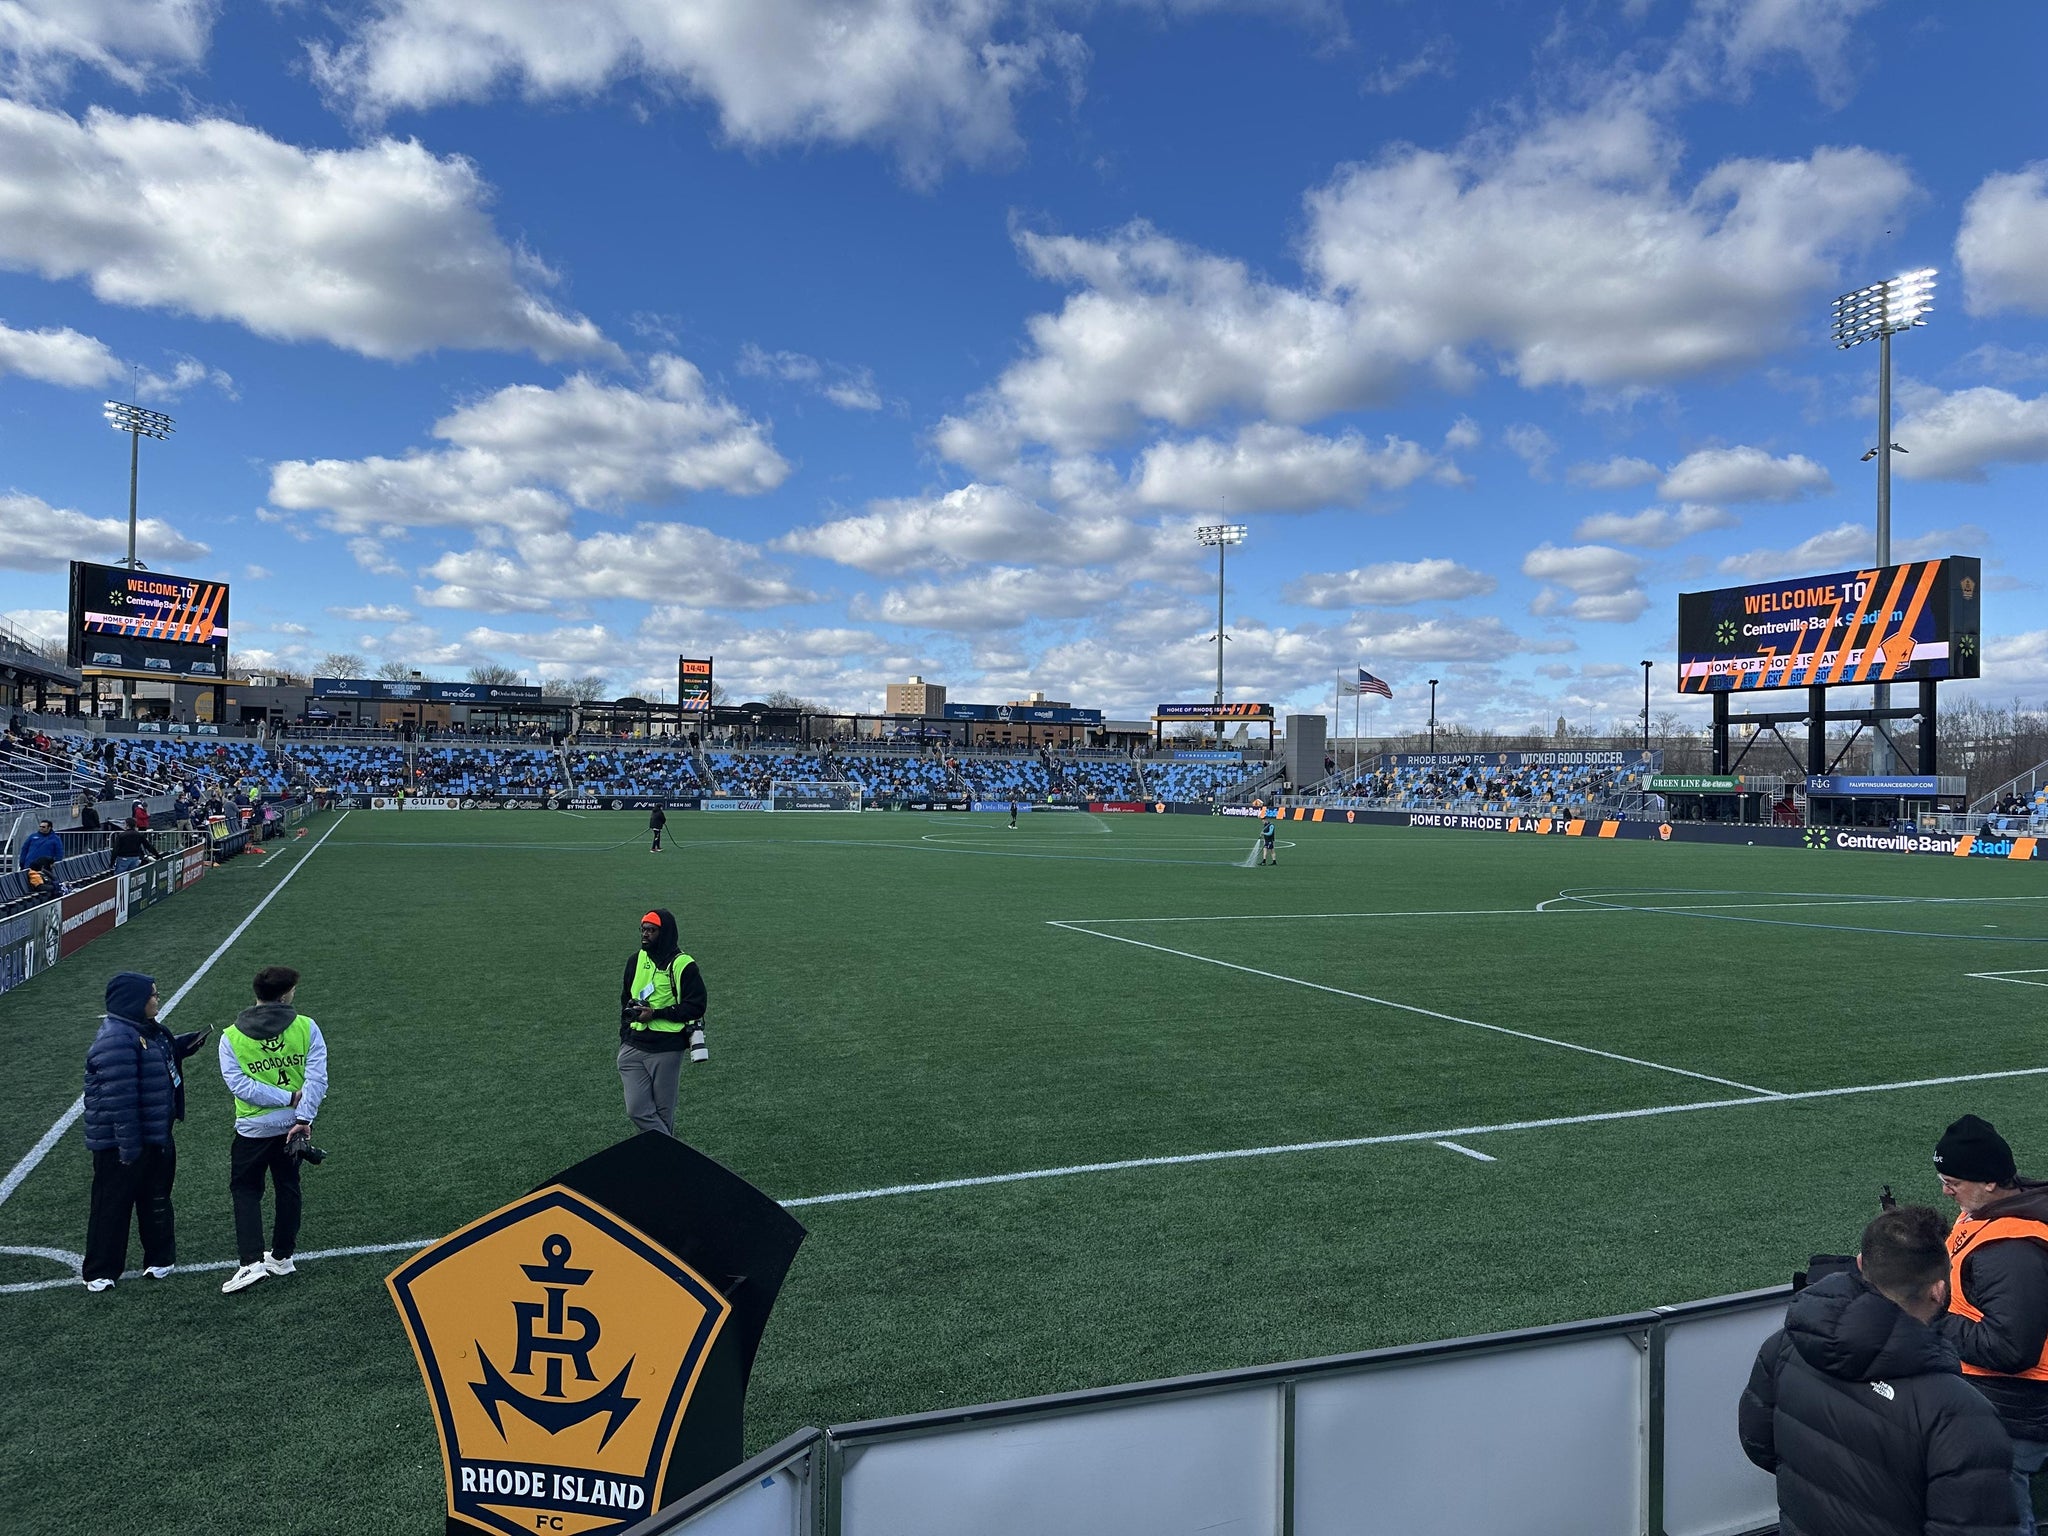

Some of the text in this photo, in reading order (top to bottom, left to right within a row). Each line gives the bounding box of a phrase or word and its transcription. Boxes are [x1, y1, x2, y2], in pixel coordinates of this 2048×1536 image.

[127, 579, 193, 599] WELCOME TO
[1744, 581, 1867, 615] WELCOME TO
[103, 615, 123, 624] HOME
[685, 664, 706, 673] 14:41
[1707, 662, 1738, 673] HOME
[1740, 661, 1756, 670] OF
[441, 690, 476, 698] Breeze
[1407, 755, 1437, 765] RHODE
[1474, 754, 1486, 764] FC
[1520, 752, 1556, 765] WICKED
[1557, 752, 1583, 765] GOOD
[1652, 779, 1679, 788] GREEN
[1681, 779, 1700, 788] LINE
[411, 798, 445, 806] GUILD
[1410, 814, 1441, 826] HOME
[1443, 815, 1458, 826] OF
[1461, 816, 1502, 830] RHODE
[24, 939, 35, 980] 37
[247, 1054, 305, 1075] BROADCAST
[277, 1069, 291, 1087] 4
[460, 1466, 645, 1510] RHODE ISLAND
[535, 1514, 564, 1531] FC
